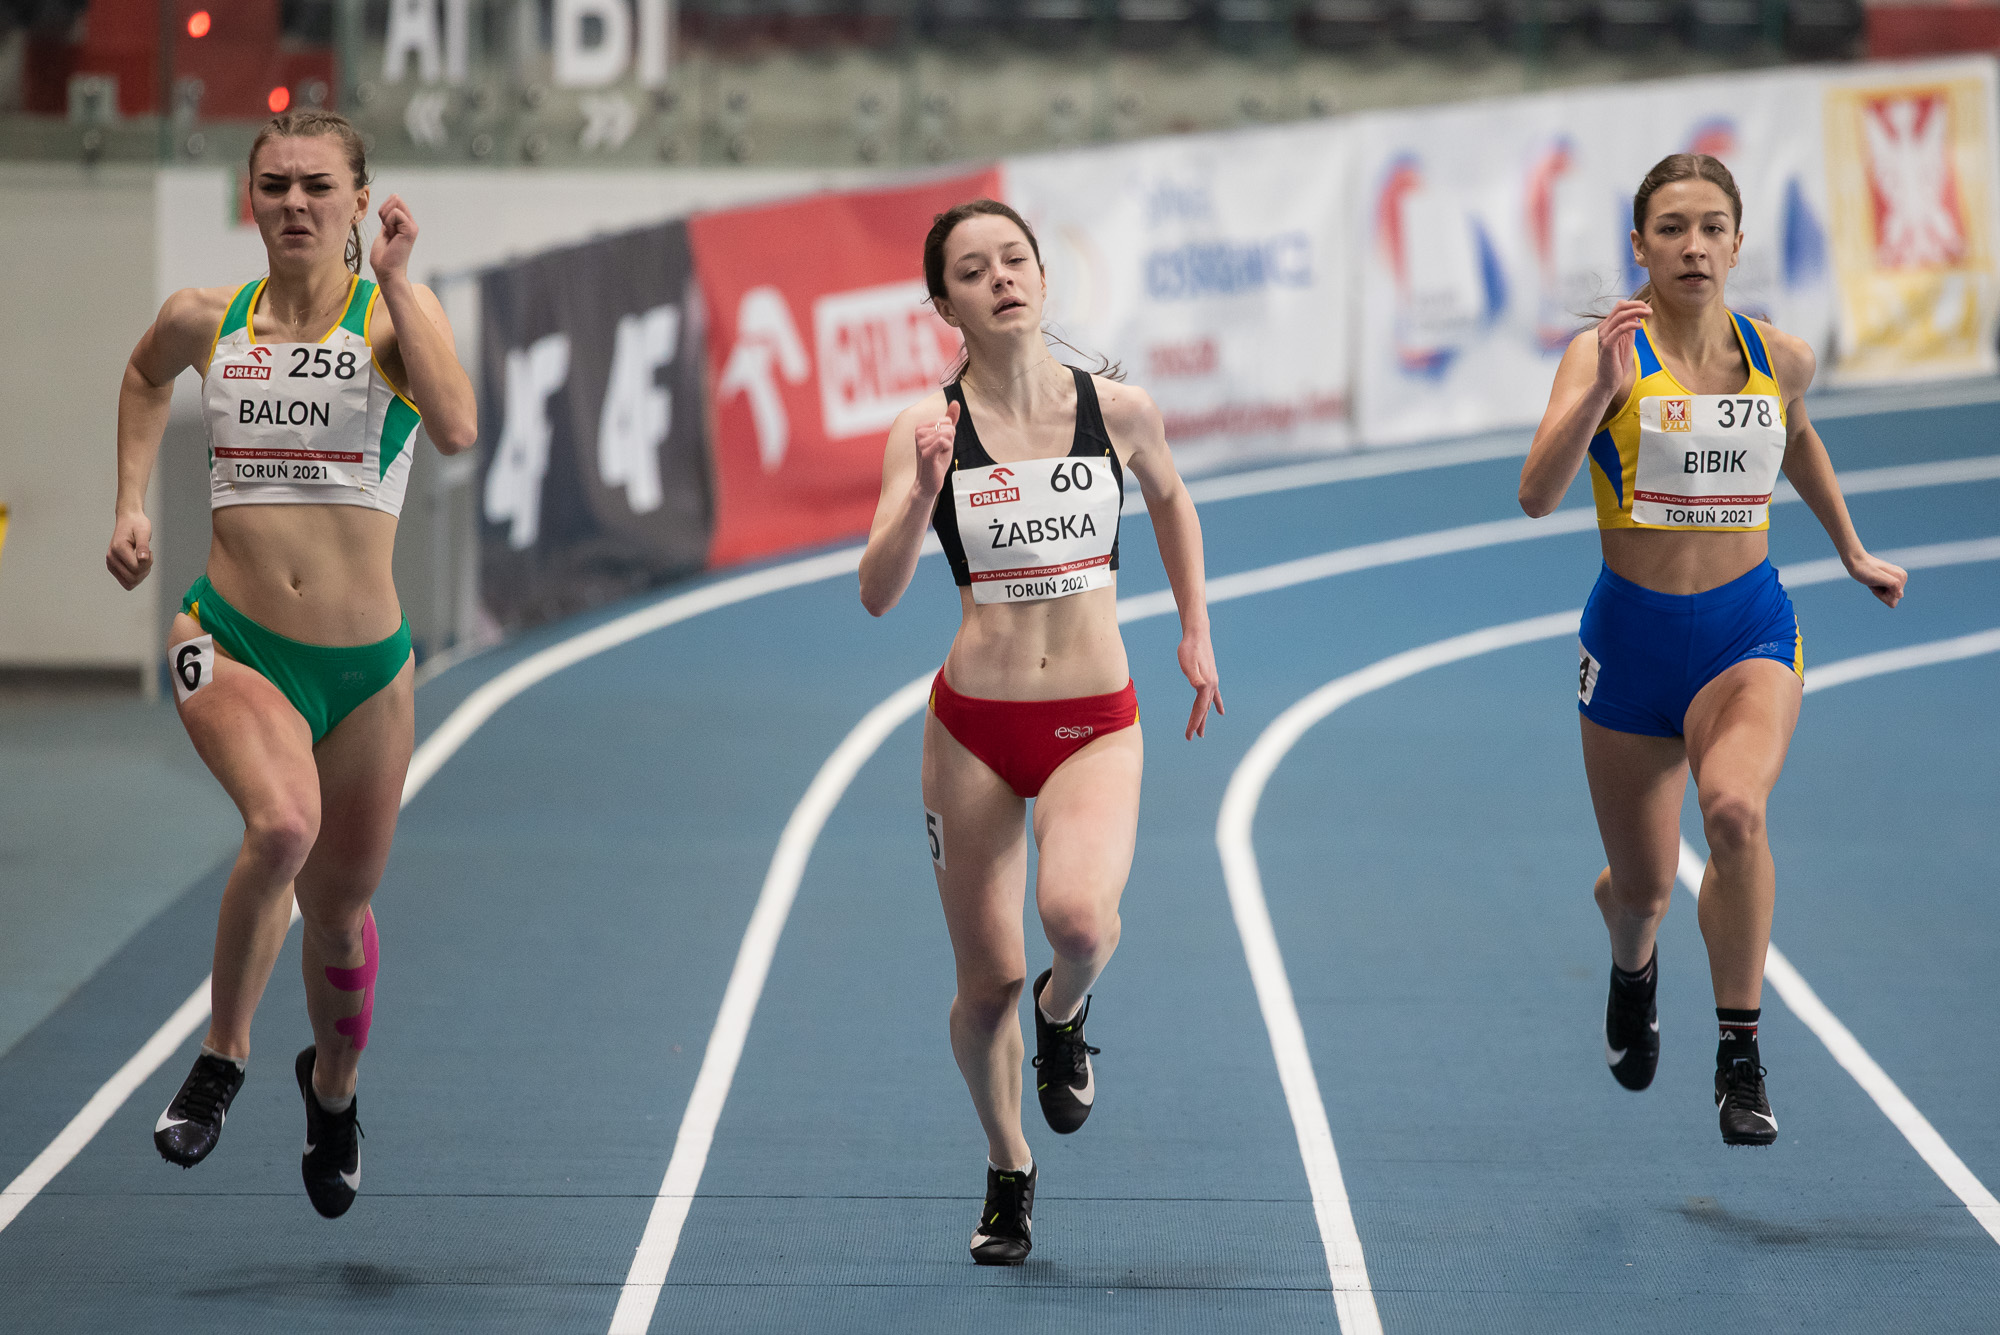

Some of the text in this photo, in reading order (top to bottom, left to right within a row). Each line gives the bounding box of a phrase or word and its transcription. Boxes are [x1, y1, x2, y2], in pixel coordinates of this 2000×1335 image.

[225, 367, 269, 379] ORLEN
[288, 348, 357, 380] 258
[239, 399, 330, 427] BALON
[1717, 399, 1773, 428] 378
[1663, 421, 1690, 431] PZLA
[235, 460, 328, 480] TORUŃ 2021
[1683, 450, 1748, 474] BIBIK
[1050, 462, 1093, 493] 60
[972, 489, 1018, 506] ORLEN
[1640, 493, 1659, 501] PZLA
[1660, 495, 1687, 504] HALOWE
[1665, 506, 1753, 523] TORUŃ 2021
[988, 513, 1097, 550] ŻABSKA
[1023, 565, 1068, 577] MISTRZOSTWA
[1067, 561, 1085, 571] POLSKI
[1005, 574, 1090, 598] TORUŃ 2021
[176, 645, 202, 692] 6
[926, 812, 941, 861] 5
